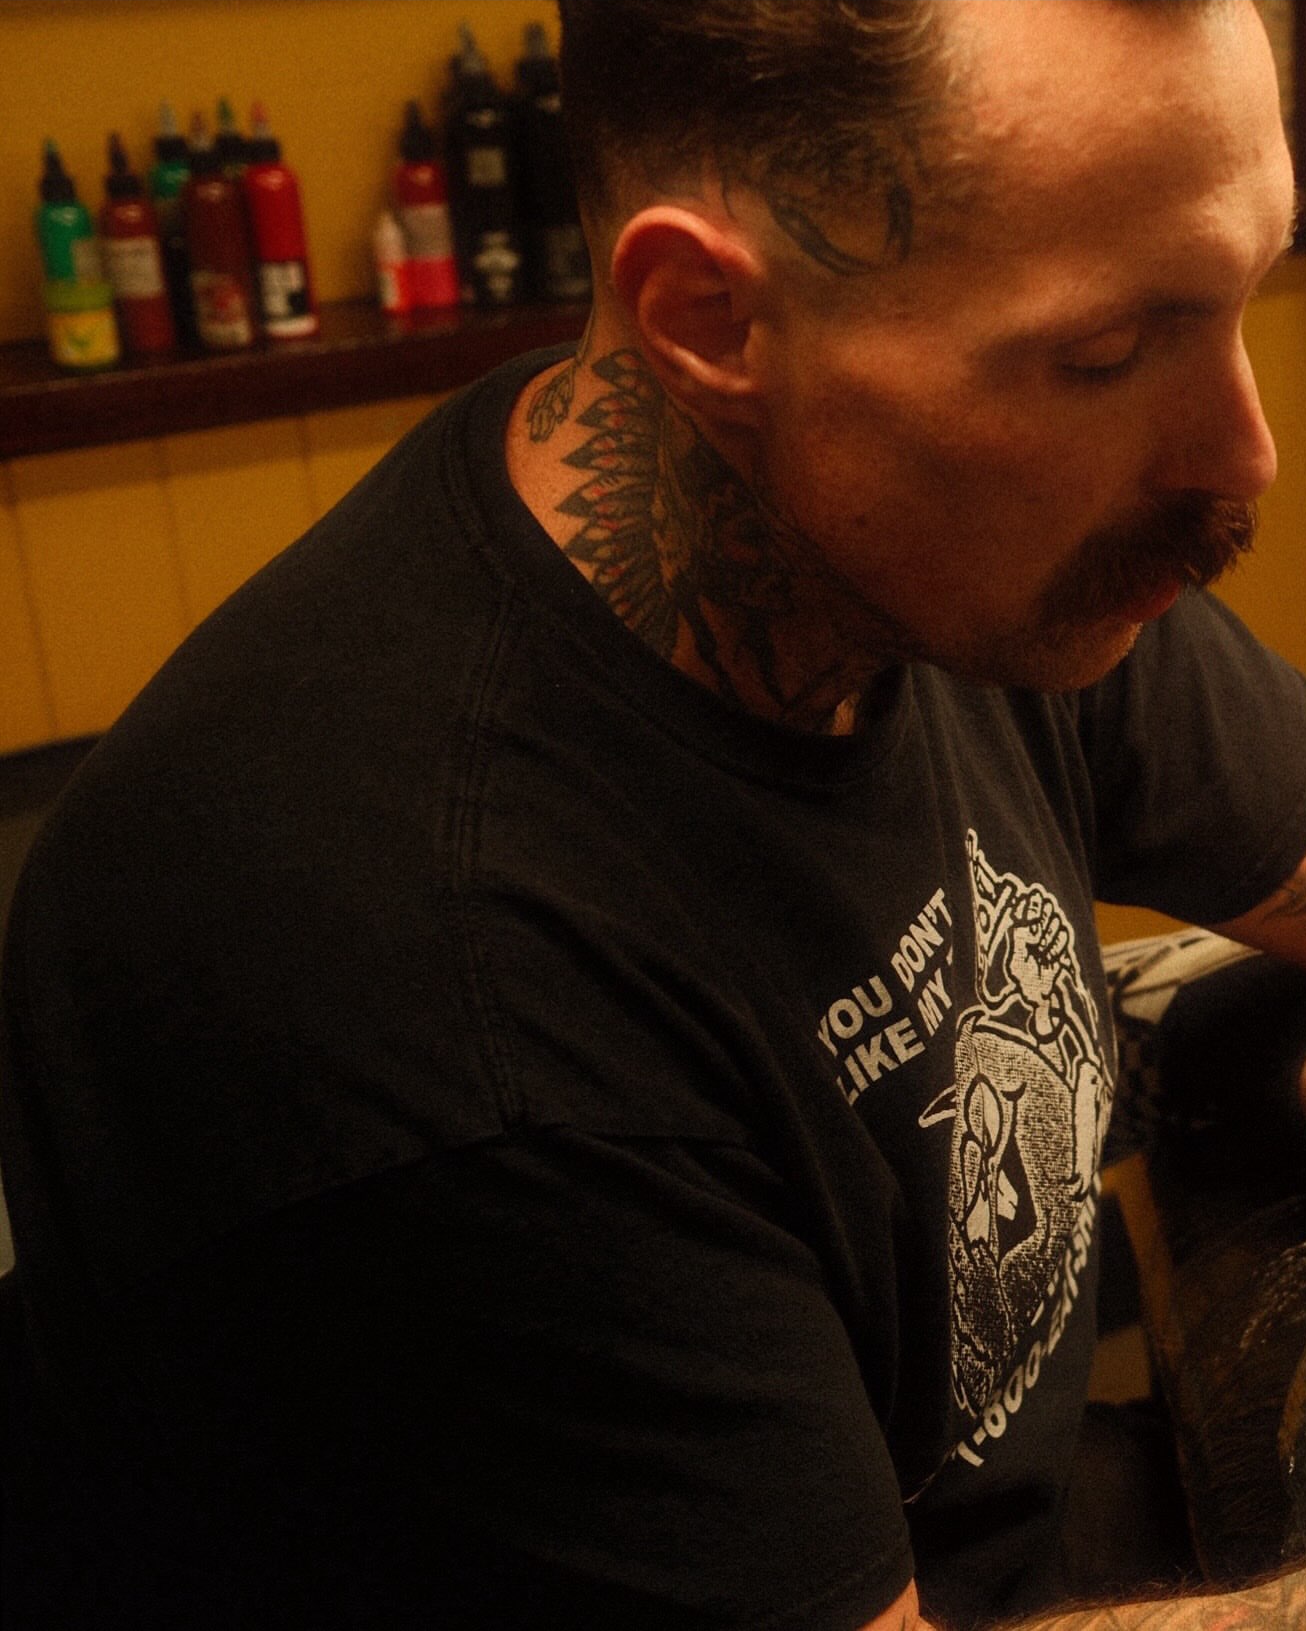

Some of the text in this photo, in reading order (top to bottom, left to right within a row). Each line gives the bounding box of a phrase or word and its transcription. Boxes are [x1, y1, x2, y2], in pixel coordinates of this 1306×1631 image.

[817, 887, 952, 1056] YOU DON'T
[836, 968, 952, 1106] LIKE MY
